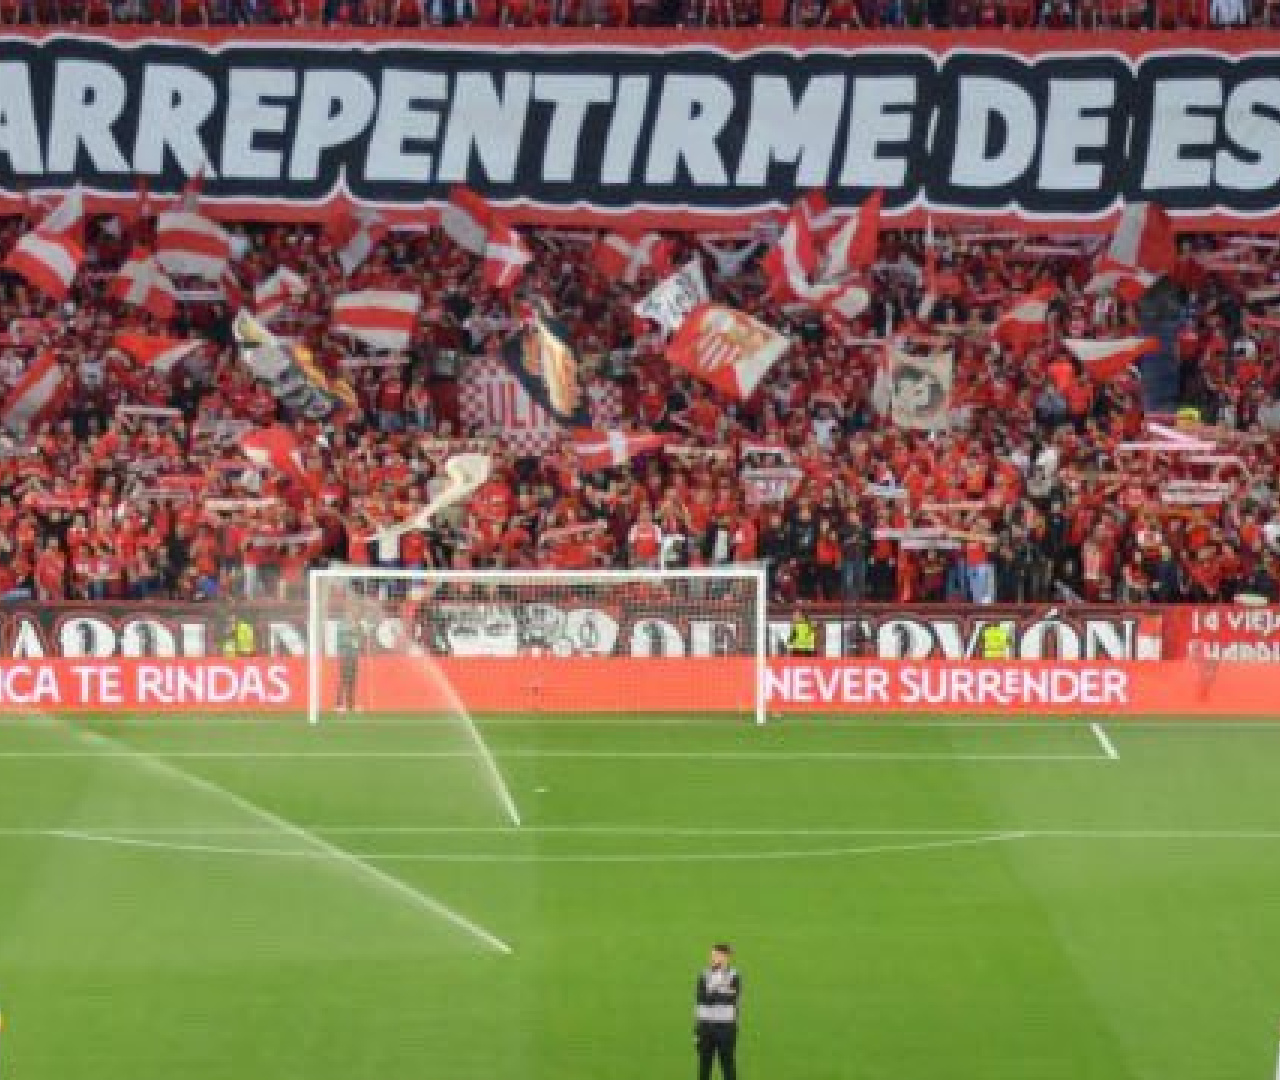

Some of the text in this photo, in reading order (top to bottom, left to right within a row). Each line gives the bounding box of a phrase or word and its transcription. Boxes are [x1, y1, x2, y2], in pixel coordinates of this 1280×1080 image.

[949, 76, 1116, 190] DE
[72, 666, 121, 702] TE
[137, 666, 290, 703] RINDAS
[765, 666, 1127, 703] NEVER SURRENDER
